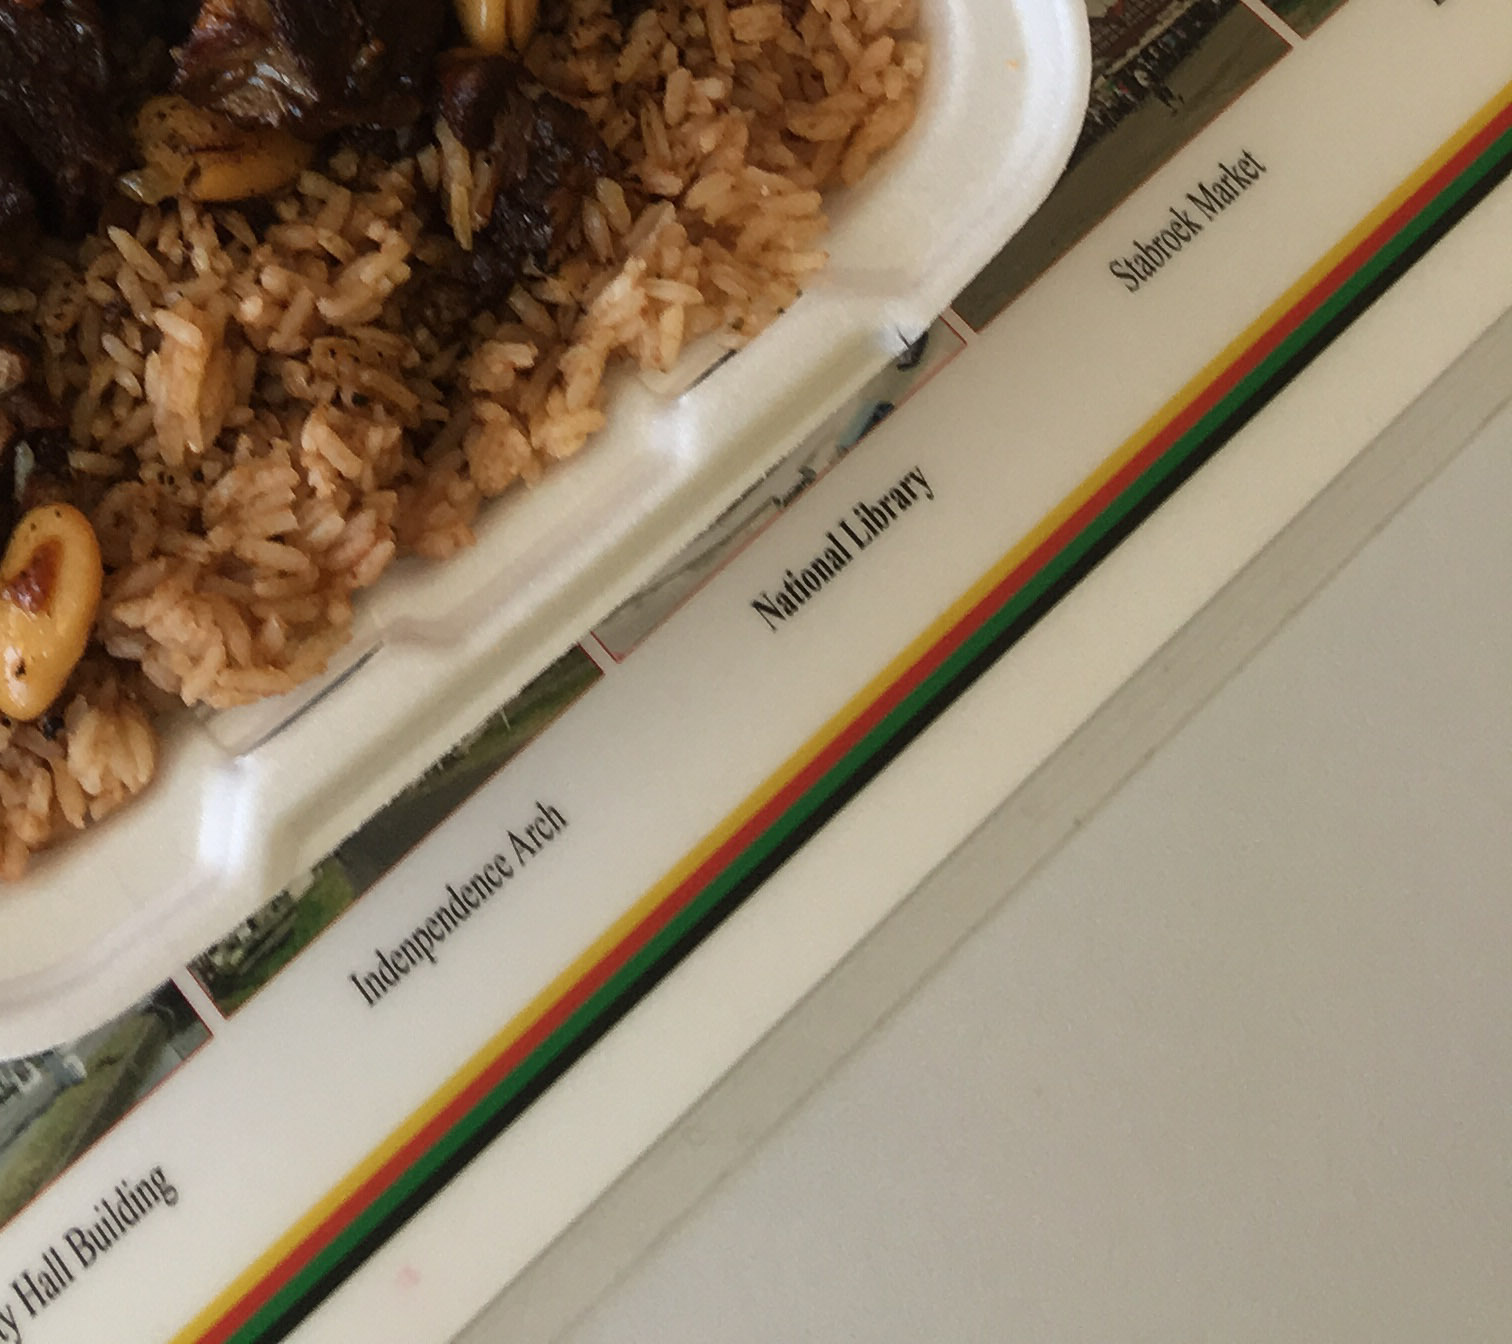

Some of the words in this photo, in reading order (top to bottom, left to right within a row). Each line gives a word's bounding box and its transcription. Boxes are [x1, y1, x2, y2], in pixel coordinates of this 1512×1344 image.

[1108, 203, 1200, 295] Stabroek
[1187, 146, 1269, 235] Market
[748, 532, 852, 632] National
[834, 461, 937, 557] Library
[347, 844, 516, 1009] Indenpendence
[503, 797, 570, 873] Arch
[9, 1244, 76, 1322] Hall
[65, 1164, 181, 1278] Building
